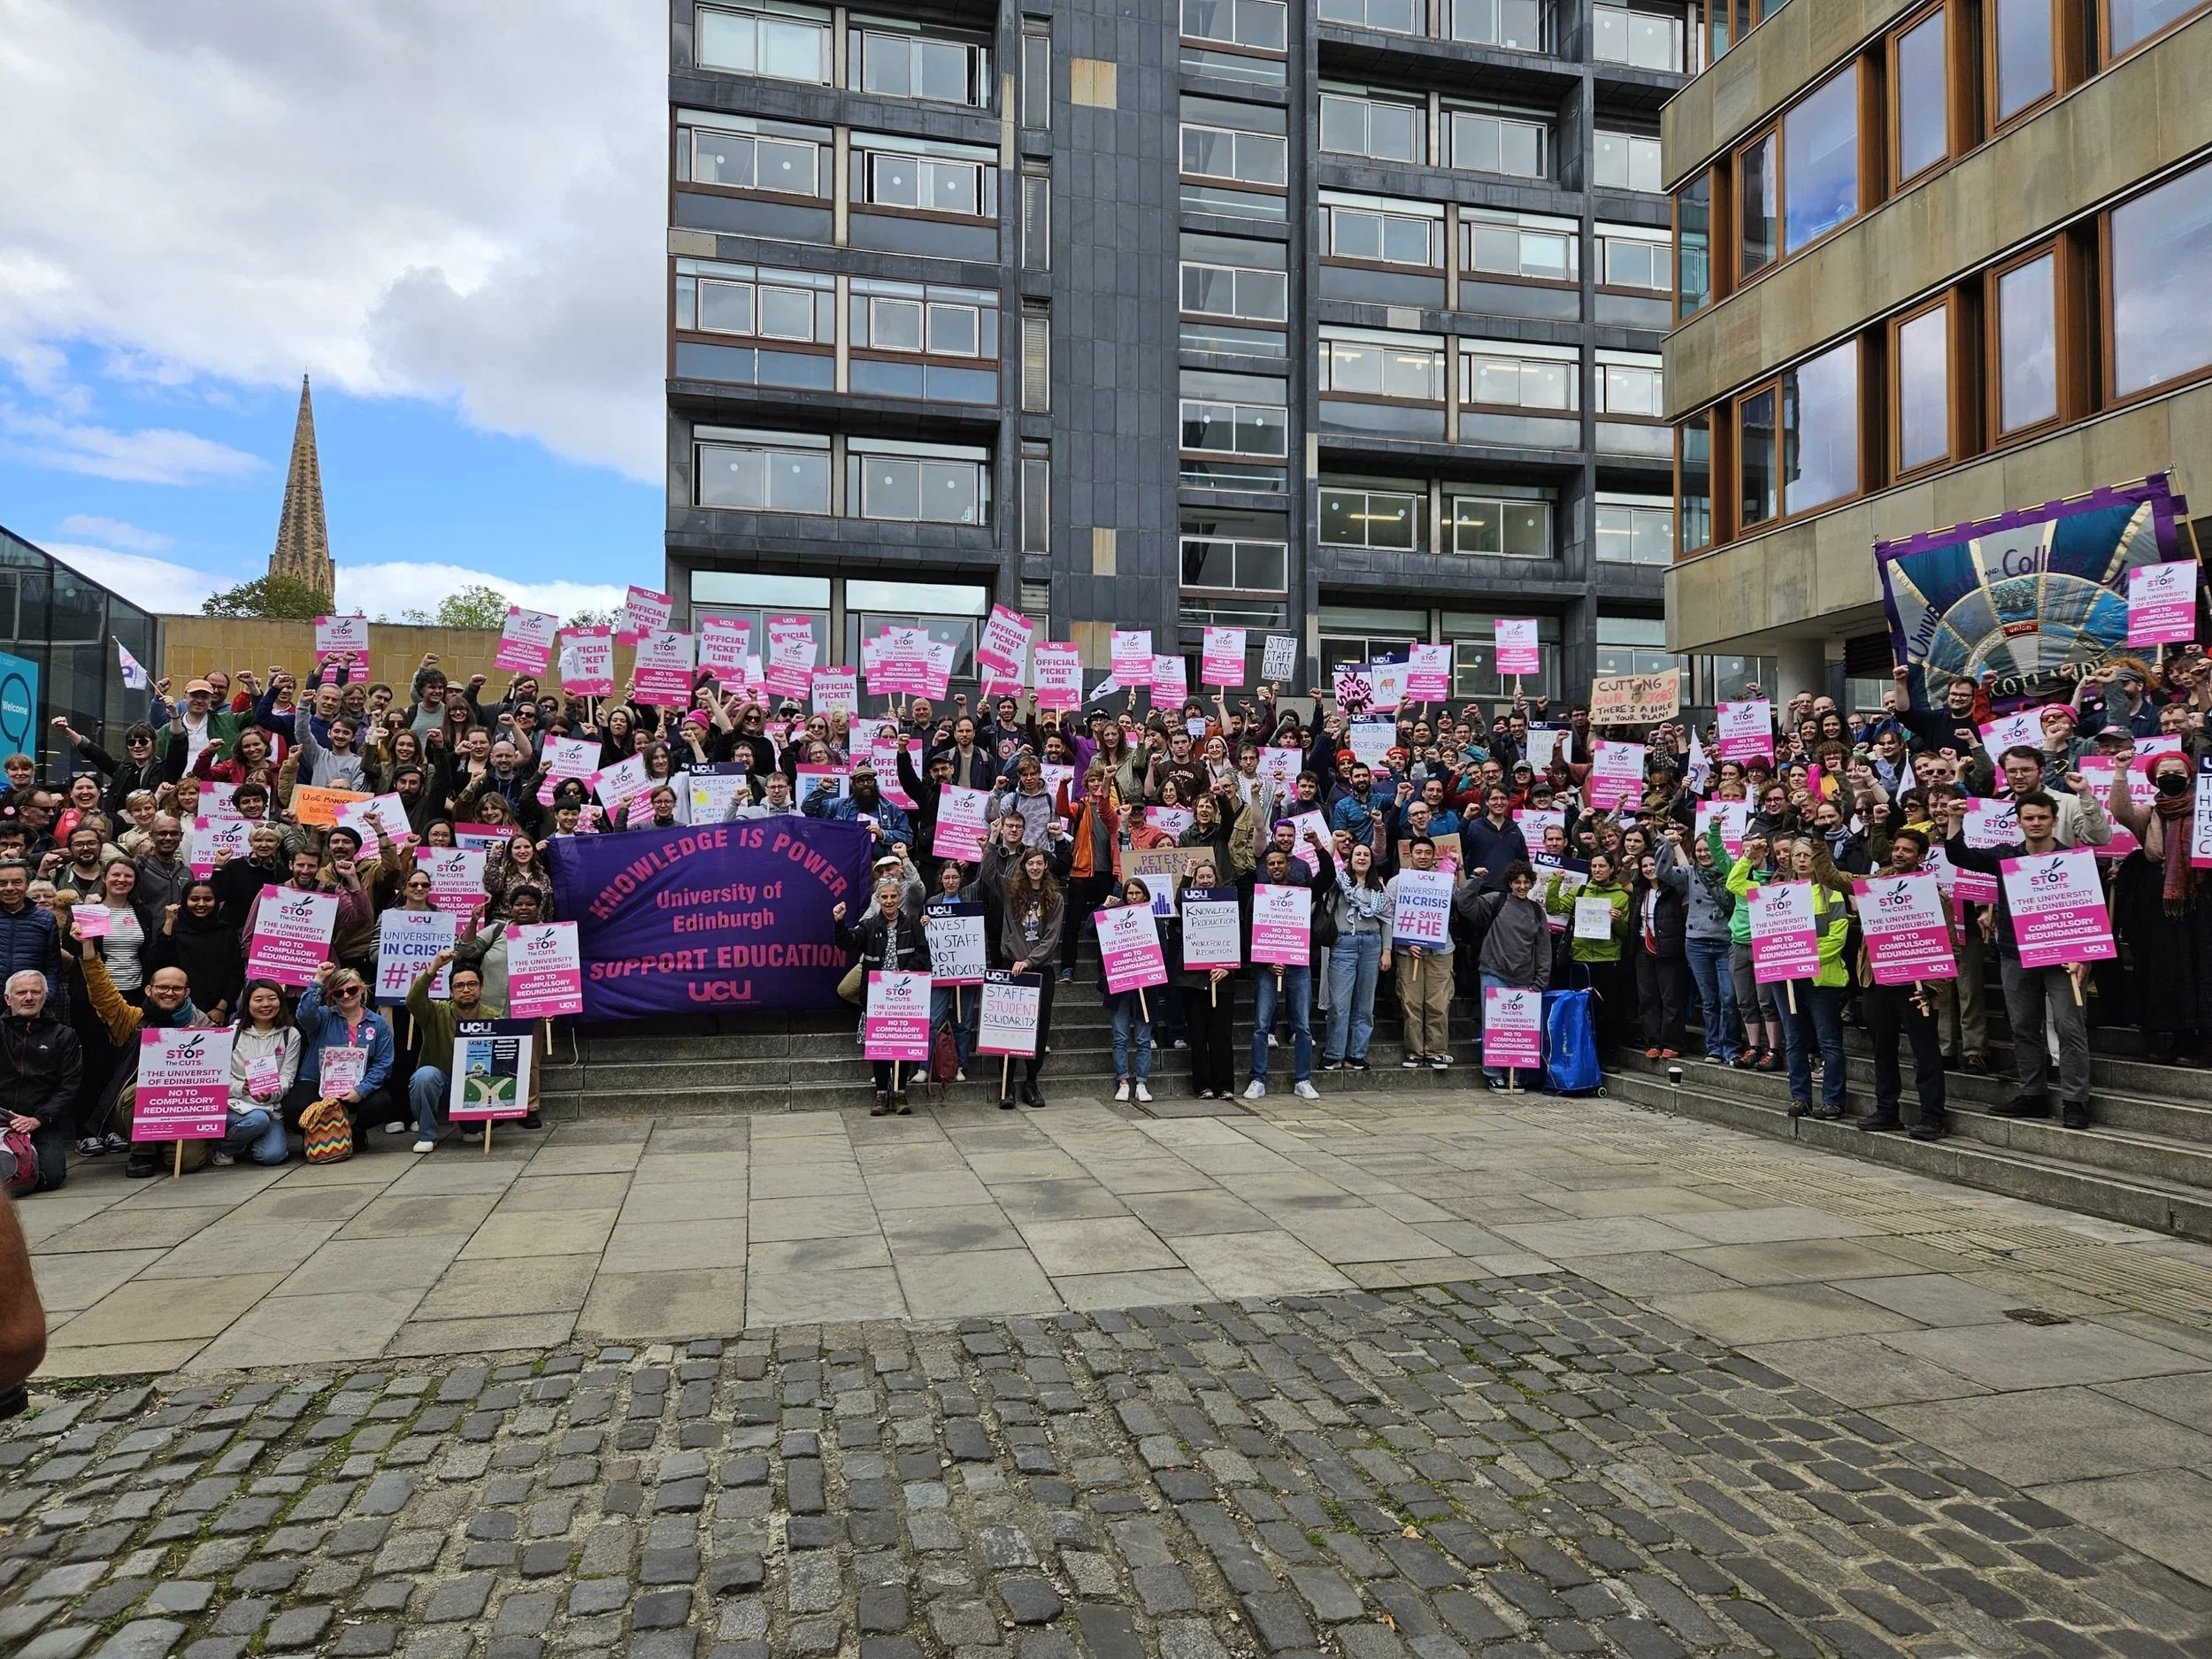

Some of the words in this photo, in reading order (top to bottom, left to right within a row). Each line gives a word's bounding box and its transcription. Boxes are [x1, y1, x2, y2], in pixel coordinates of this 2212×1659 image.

[1985, 567, 2000, 577] AND
[626, 602, 667, 618] OFFICIAL
[628, 611, 662, 626] PICKET
[1008, 611, 1020, 622] UCU
[989, 620, 1026, 643] OFFICIAL
[703, 634, 747, 645] OFFICIAL
[990, 631, 1021, 649] PICKET
[1268, 637, 1294, 649] STOP
[707, 644, 741, 654] PICKET
[993, 641, 1012, 656] LINE
[1265, 650, 1293, 662] STAFF
[1263, 663, 1289, 675] CUTS
[1347, 688, 1360, 697] in
[1594, 695, 1623, 705] OUR
[2, 701, 28, 715] Welcome
[1596, 704, 1635, 715] THERE'S
[1650, 703, 1673, 711] HOLE
[1640, 711, 1669, 720] PLAN!
[1727, 741, 1765, 750] COMPULSORY
[691, 764, 716, 773] UCU
[1141, 853, 1190, 864] PETER'S
[1538, 854, 1561, 864] UCU
[588, 828, 729, 920] KNOWLEDGE
[740, 827, 764, 849] IS
[772, 832, 848, 897] POWER
[1134, 864, 1162, 875] MATH
[1168, 864, 1178, 873] IS
[2031, 872, 2069, 886] STOP
[657, 883, 755, 910] University
[763, 880, 782, 899] of
[1399, 886, 1449, 897] UNIVERSITIES
[2038, 889, 2093, 902] UNIVERSITY
[1399, 895, 1410, 903] IN
[1412, 896, 1448, 909] CRISIS
[1879, 894, 1913, 907] STOP
[2037, 898, 2093, 911] EDINBURGH
[927, 906, 952, 915] UCU
[1187, 906, 1236, 917] KNOWLEDGE
[1419, 911, 1442, 921] SAVE
[673, 908, 775, 933] Edinburgh
[1192, 917, 1236, 927] PRODUCTION
[1398, 911, 1416, 932] #
[1887, 911, 1935, 923] UNIVERSITY
[2044, 913, 2060, 922] NO
[1417, 920, 1441, 936] HE
[1886, 919, 1935, 932] EDINBURGH
[2028, 918, 2094, 932] COMPULSORY
[383, 932, 452, 941] UNIVERSITIES
[1893, 933, 1906, 942] NO
[1908, 932, 1919, 941] TO
[2024, 926, 2102, 941] REDUNDANCIES!
[944, 933, 979, 948] STAFF
[1879, 938, 1936, 951] COMPULSORY
[383, 943, 400, 955] IN
[1877, 946, 1944, 960] REDUNDANCIES!
[2083, 944, 2108, 954] UCU
[589, 948, 708, 981] SUPPORT
[717, 943, 847, 968] EDUCATION
[931, 952, 956, 963] NOT
[1928, 964, 1949, 973] UCU
[382, 963, 409, 989] #
[986, 972, 1010, 981] UCU
[687, 979, 751, 1002] UCU
[987, 1001, 1036, 1015] STUDENT
[984, 1013, 1036, 1027] SOLIDARITY
[459, 1022, 492, 1033] UCU
[166, 1049, 204, 1059] STOP
[143, 1105, 219, 1114] REDUNDANCIES!
